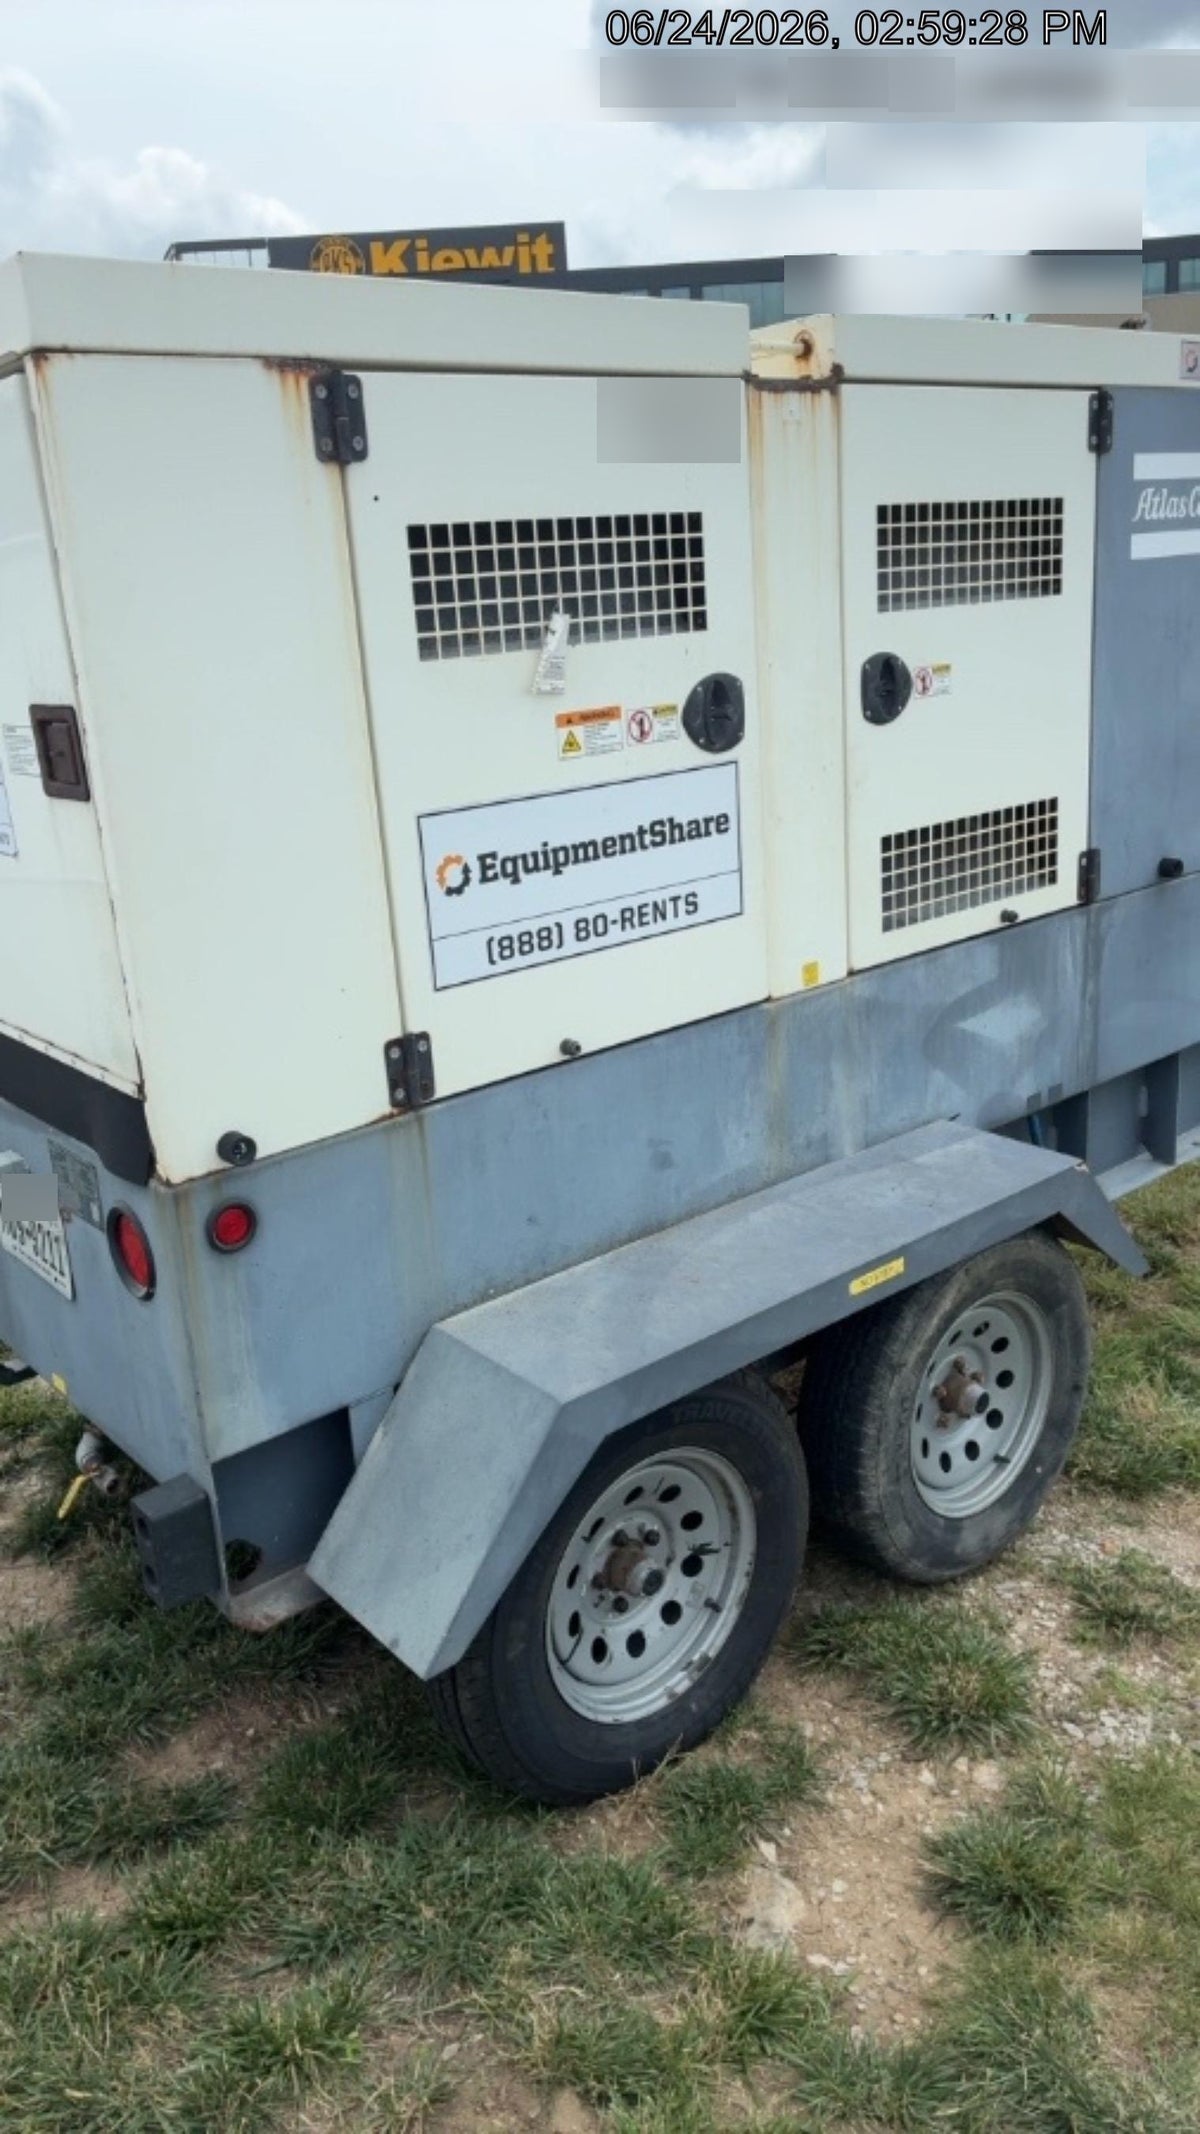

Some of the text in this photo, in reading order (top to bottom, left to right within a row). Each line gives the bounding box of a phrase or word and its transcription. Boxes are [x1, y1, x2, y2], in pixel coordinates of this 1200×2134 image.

[370, 234, 555, 274] Kiewit
[476, 812, 730, 885] EquipmentShare
[486, 891, 699, 965] (888) 80-RENTS
